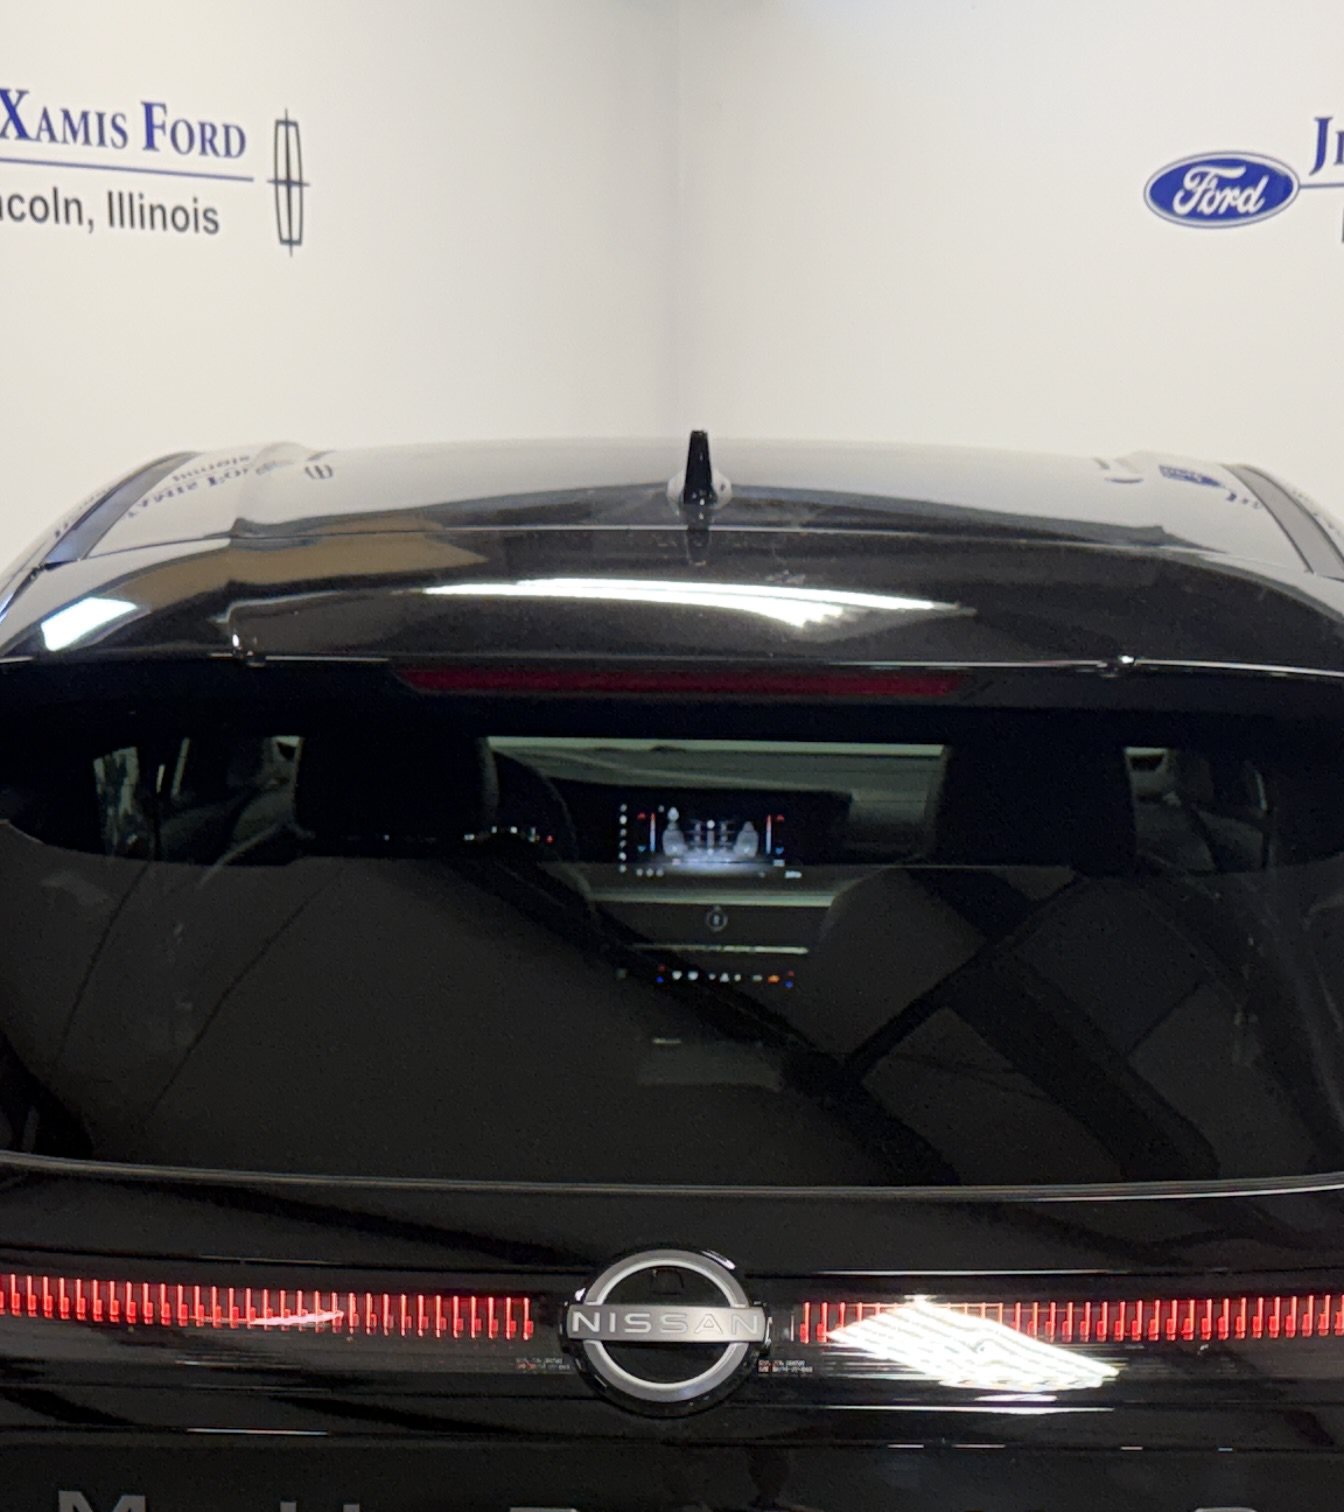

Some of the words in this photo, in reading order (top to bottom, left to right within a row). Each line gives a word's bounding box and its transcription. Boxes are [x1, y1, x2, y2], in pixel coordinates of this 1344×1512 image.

[107, 191, 220, 235] Illinois
[1172, 164, 1267, 218] Ford
[570, 1311, 759, 1335] NISSAN
